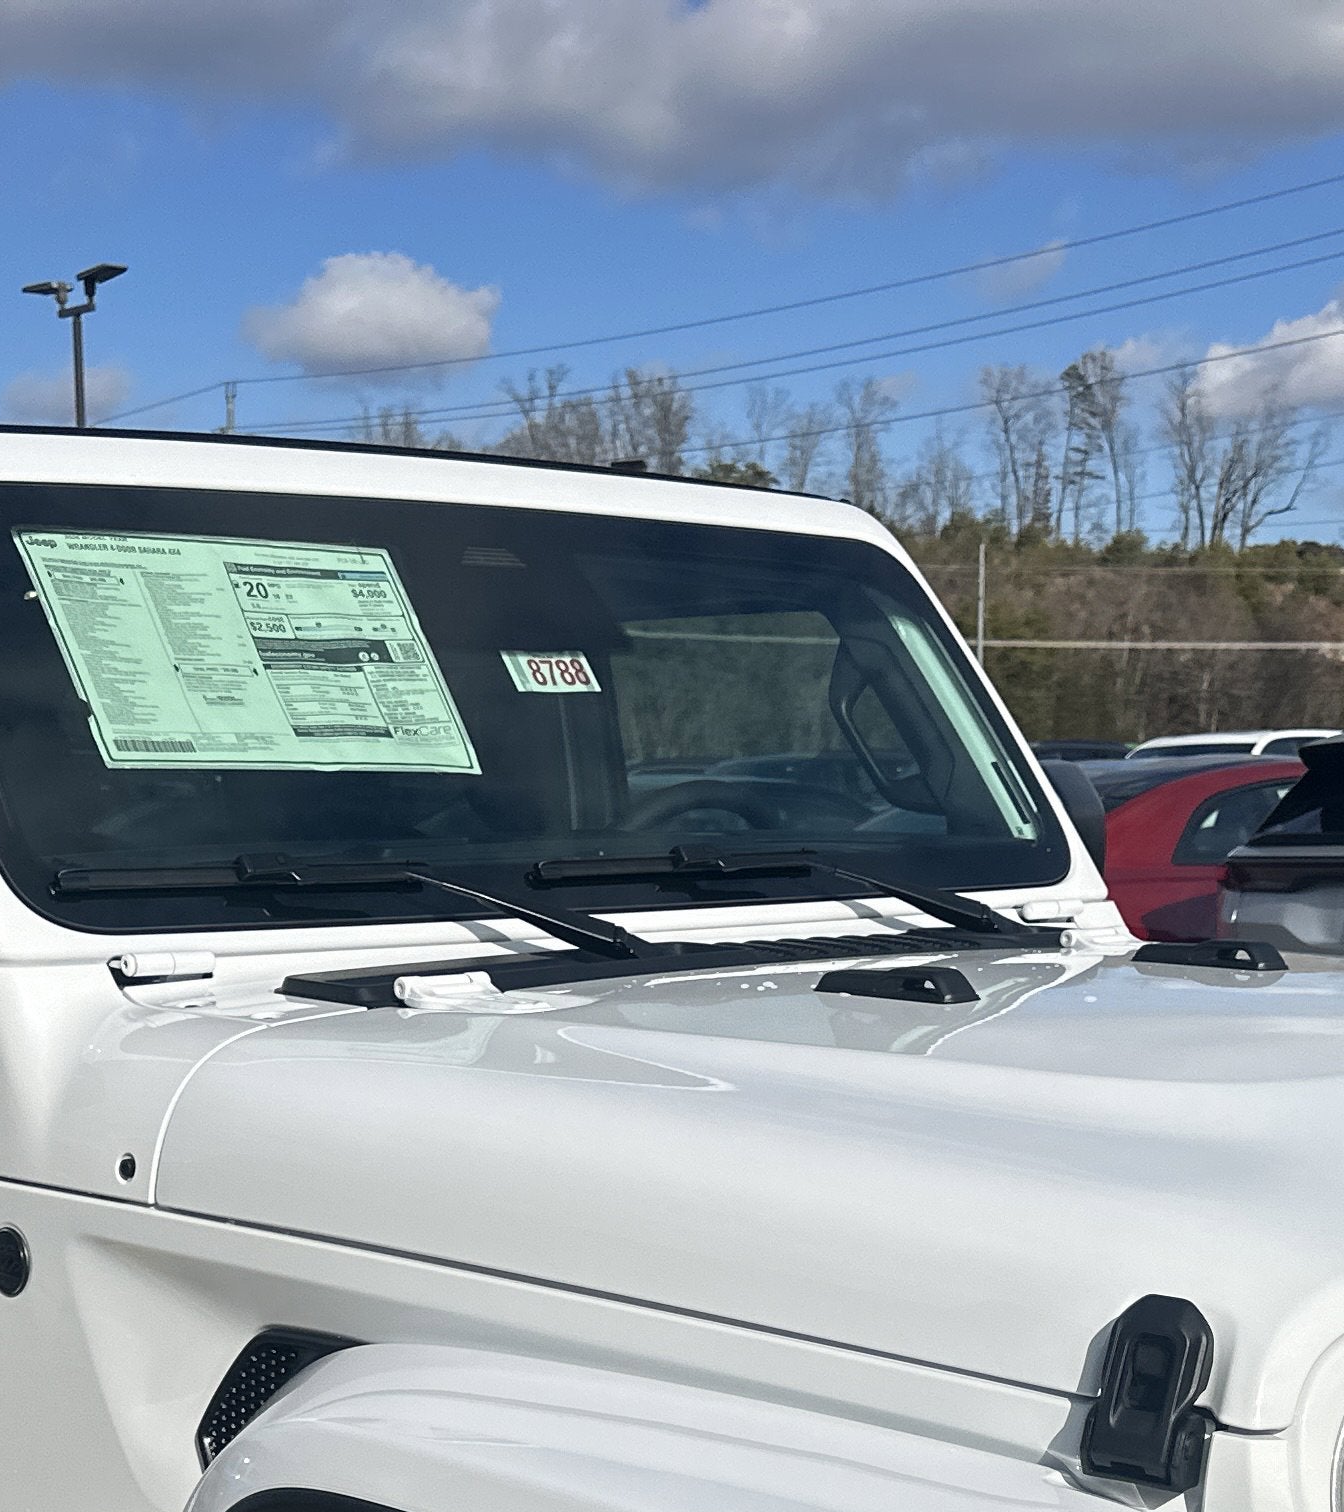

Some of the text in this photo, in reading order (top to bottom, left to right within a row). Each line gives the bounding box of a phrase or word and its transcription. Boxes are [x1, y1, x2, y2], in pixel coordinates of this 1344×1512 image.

[25, 535, 58, 549] Jeep
[66, 543, 109, 551] WRANGLER
[242, 581, 269, 600] 20
[527, 658, 591, 686] 8788
[393, 724, 452, 737] FlexCare
